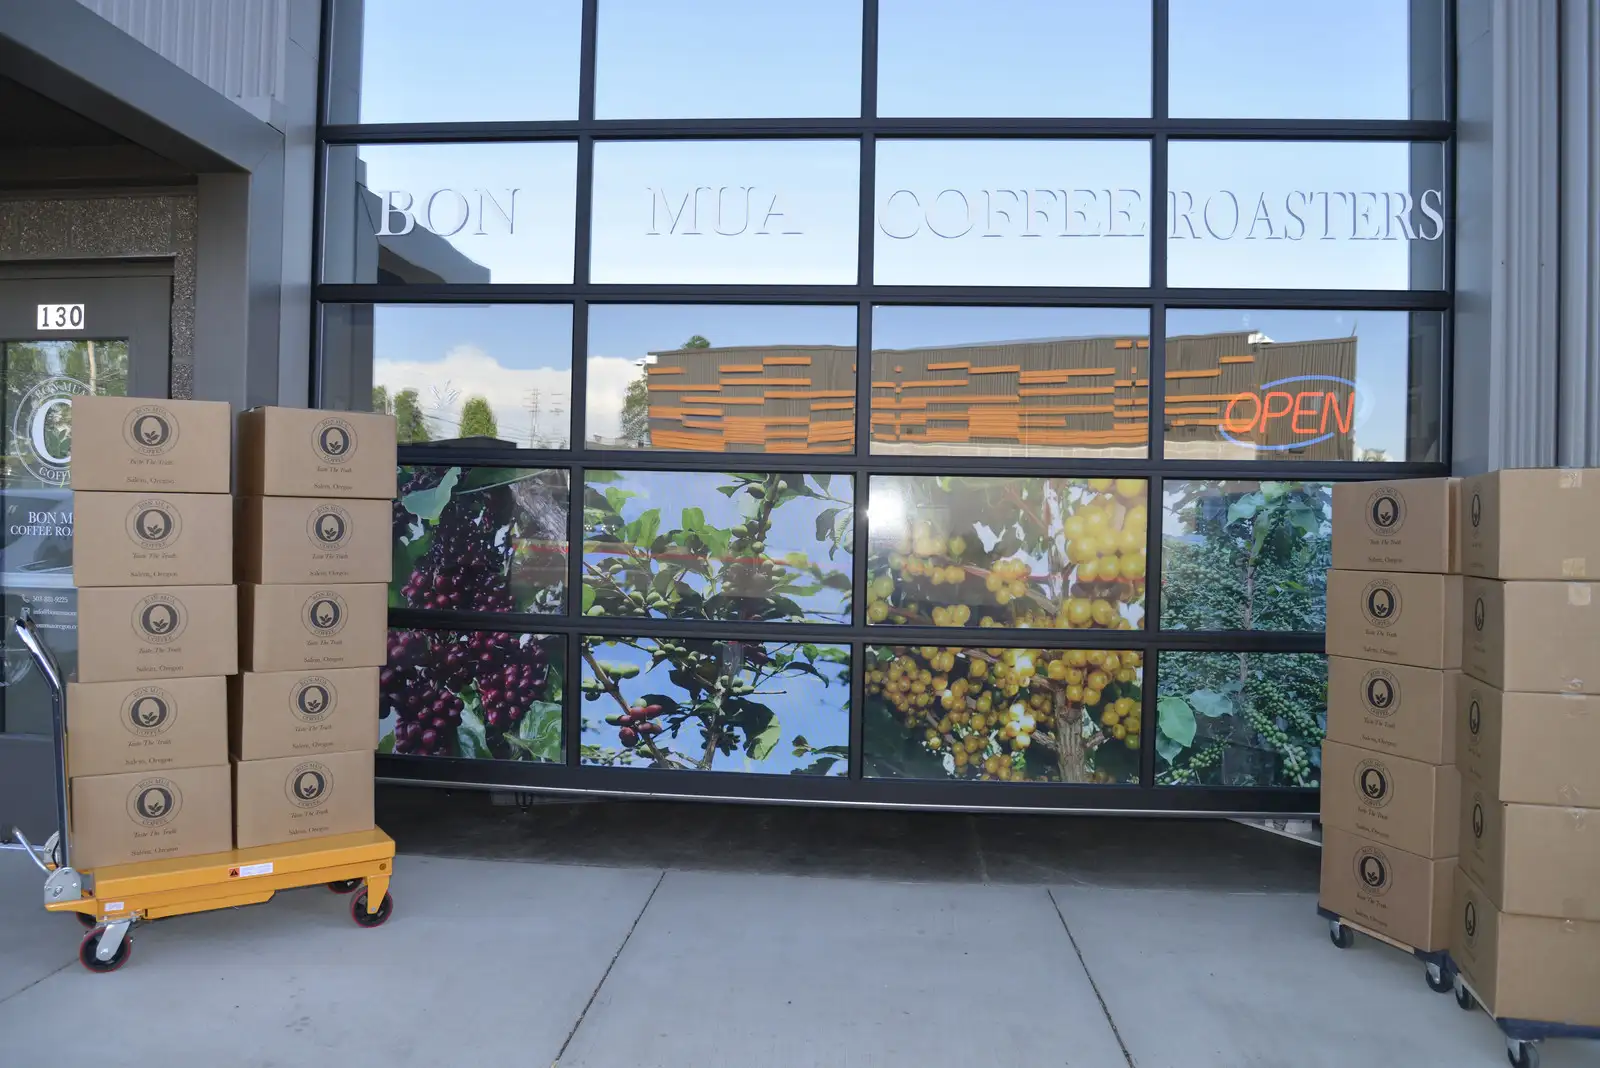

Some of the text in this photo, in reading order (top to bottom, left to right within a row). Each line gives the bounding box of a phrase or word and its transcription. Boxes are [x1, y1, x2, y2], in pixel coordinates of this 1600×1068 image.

[374, 186, 1445, 241] BON MUA COFFEE ROASTERS
[42, 305, 82, 327] 130
[34, 382, 59, 400] BON
[1225, 391, 1355, 434] OPEN
[28, 511, 57, 525] BON
[10, 525, 53, 536] COFFEE
